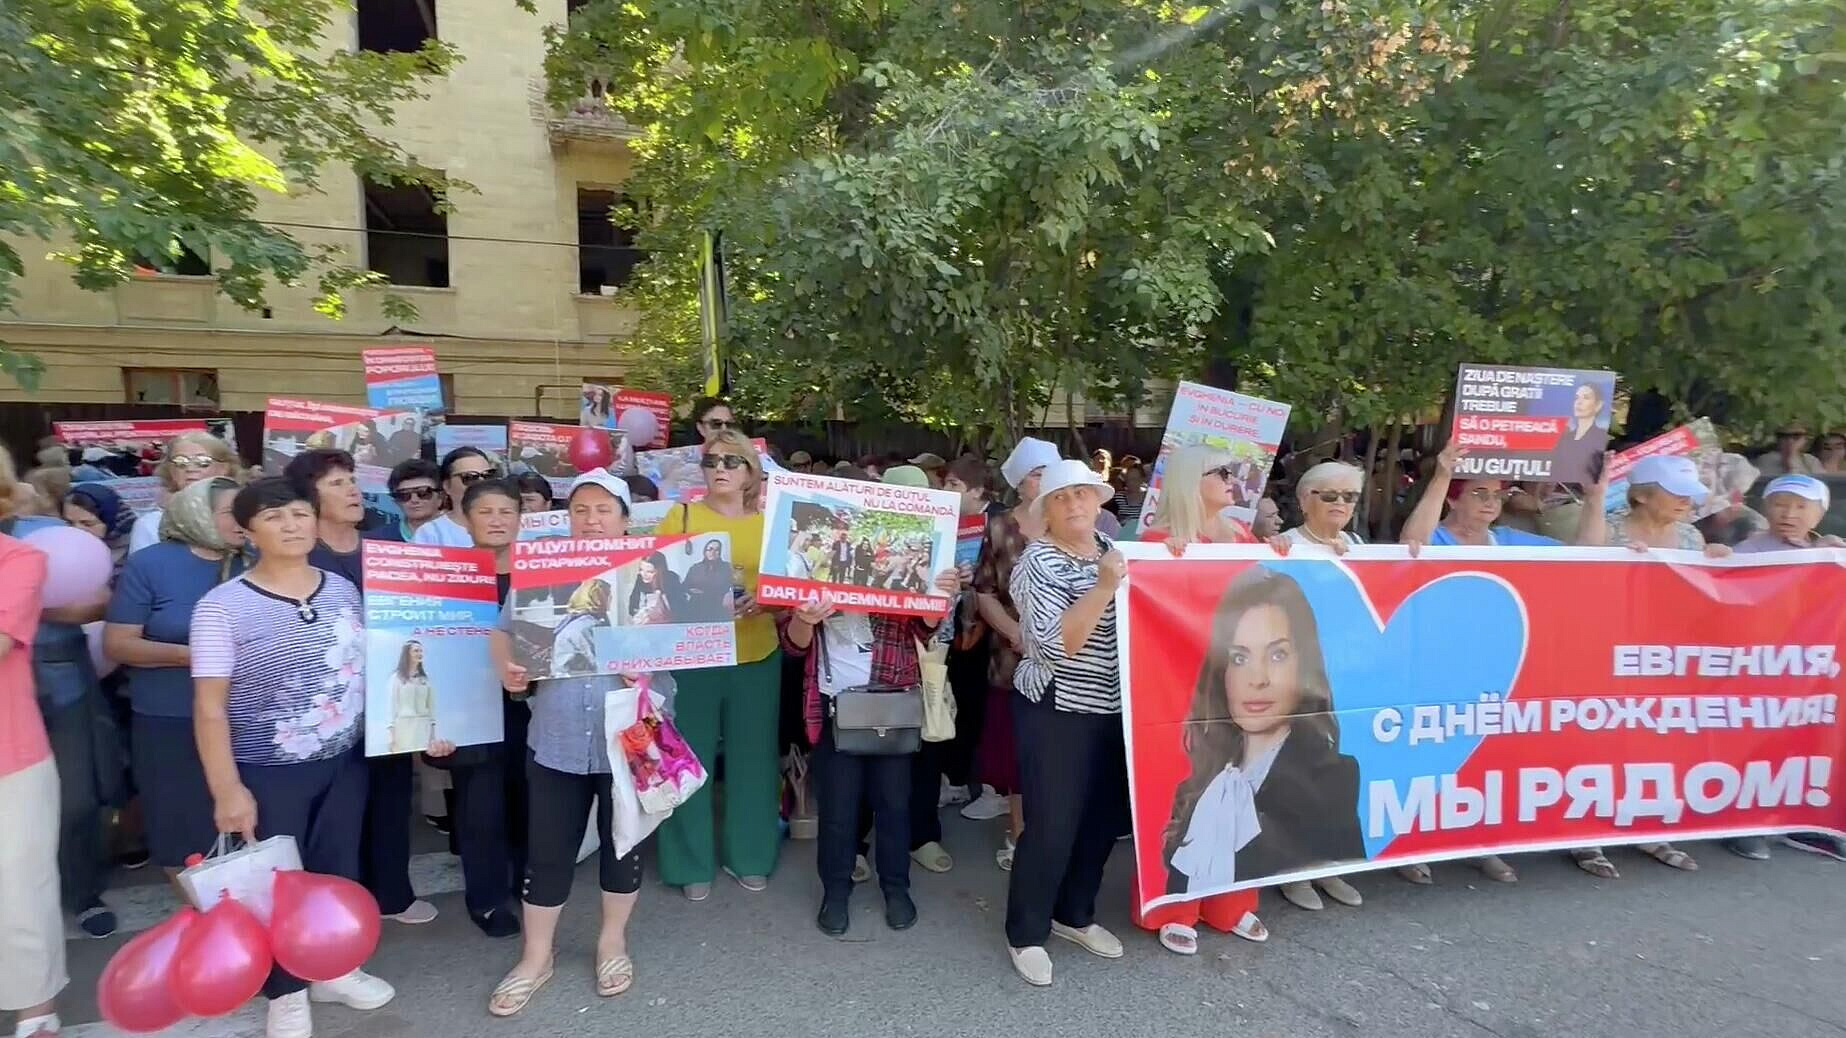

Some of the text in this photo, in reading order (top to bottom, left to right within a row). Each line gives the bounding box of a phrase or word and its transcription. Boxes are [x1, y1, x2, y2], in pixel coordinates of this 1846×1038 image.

[1463, 369, 1495, 383] ZIUA
[1496, 370, 1515, 384] DE
[1461, 400, 1517, 413] TREBUIE
[1459, 416, 1478, 430] SĂ
[1481, 419, 1490, 430] O
[1459, 433, 1507, 448] SANDU,
[1455, 458, 1552, 480] NU GUȚUL!
[774, 475, 825, 490] SUNTEM
[877, 487, 892, 498] DE
[864, 498, 881, 509] NU
[881, 500, 897, 511] LA
[366, 542, 443, 558] EVGHENIA
[515, 536, 656, 555] ГУЦУЛ ПОМНИТ
[515, 556, 612, 570] О СТАРИКАХ,
[423, 573, 447, 583] NU
[366, 594, 443, 607] ЕВГЕНИЯ
[761, 585, 797, 600] DAR
[799, 588, 821, 603] LA
[821, 586, 902, 608] ÎNDEMNUL
[366, 609, 435, 622] СТРОИТ
[427, 627, 446, 636] НЕ
[687, 625, 730, 637] КОГДА
[676, 640, 731, 652] ВЛАСТЬ
[607, 652, 732, 670] О НИХ ЗАБЫВАЕТ
[1613, 644, 1841, 679] ЕВГЕНИЯ,
[1372, 692, 1837, 746] С ДНЁМ РОЖДЕНИЯ!
[1368, 755, 1832, 838] МЫ РЯДОМ!
